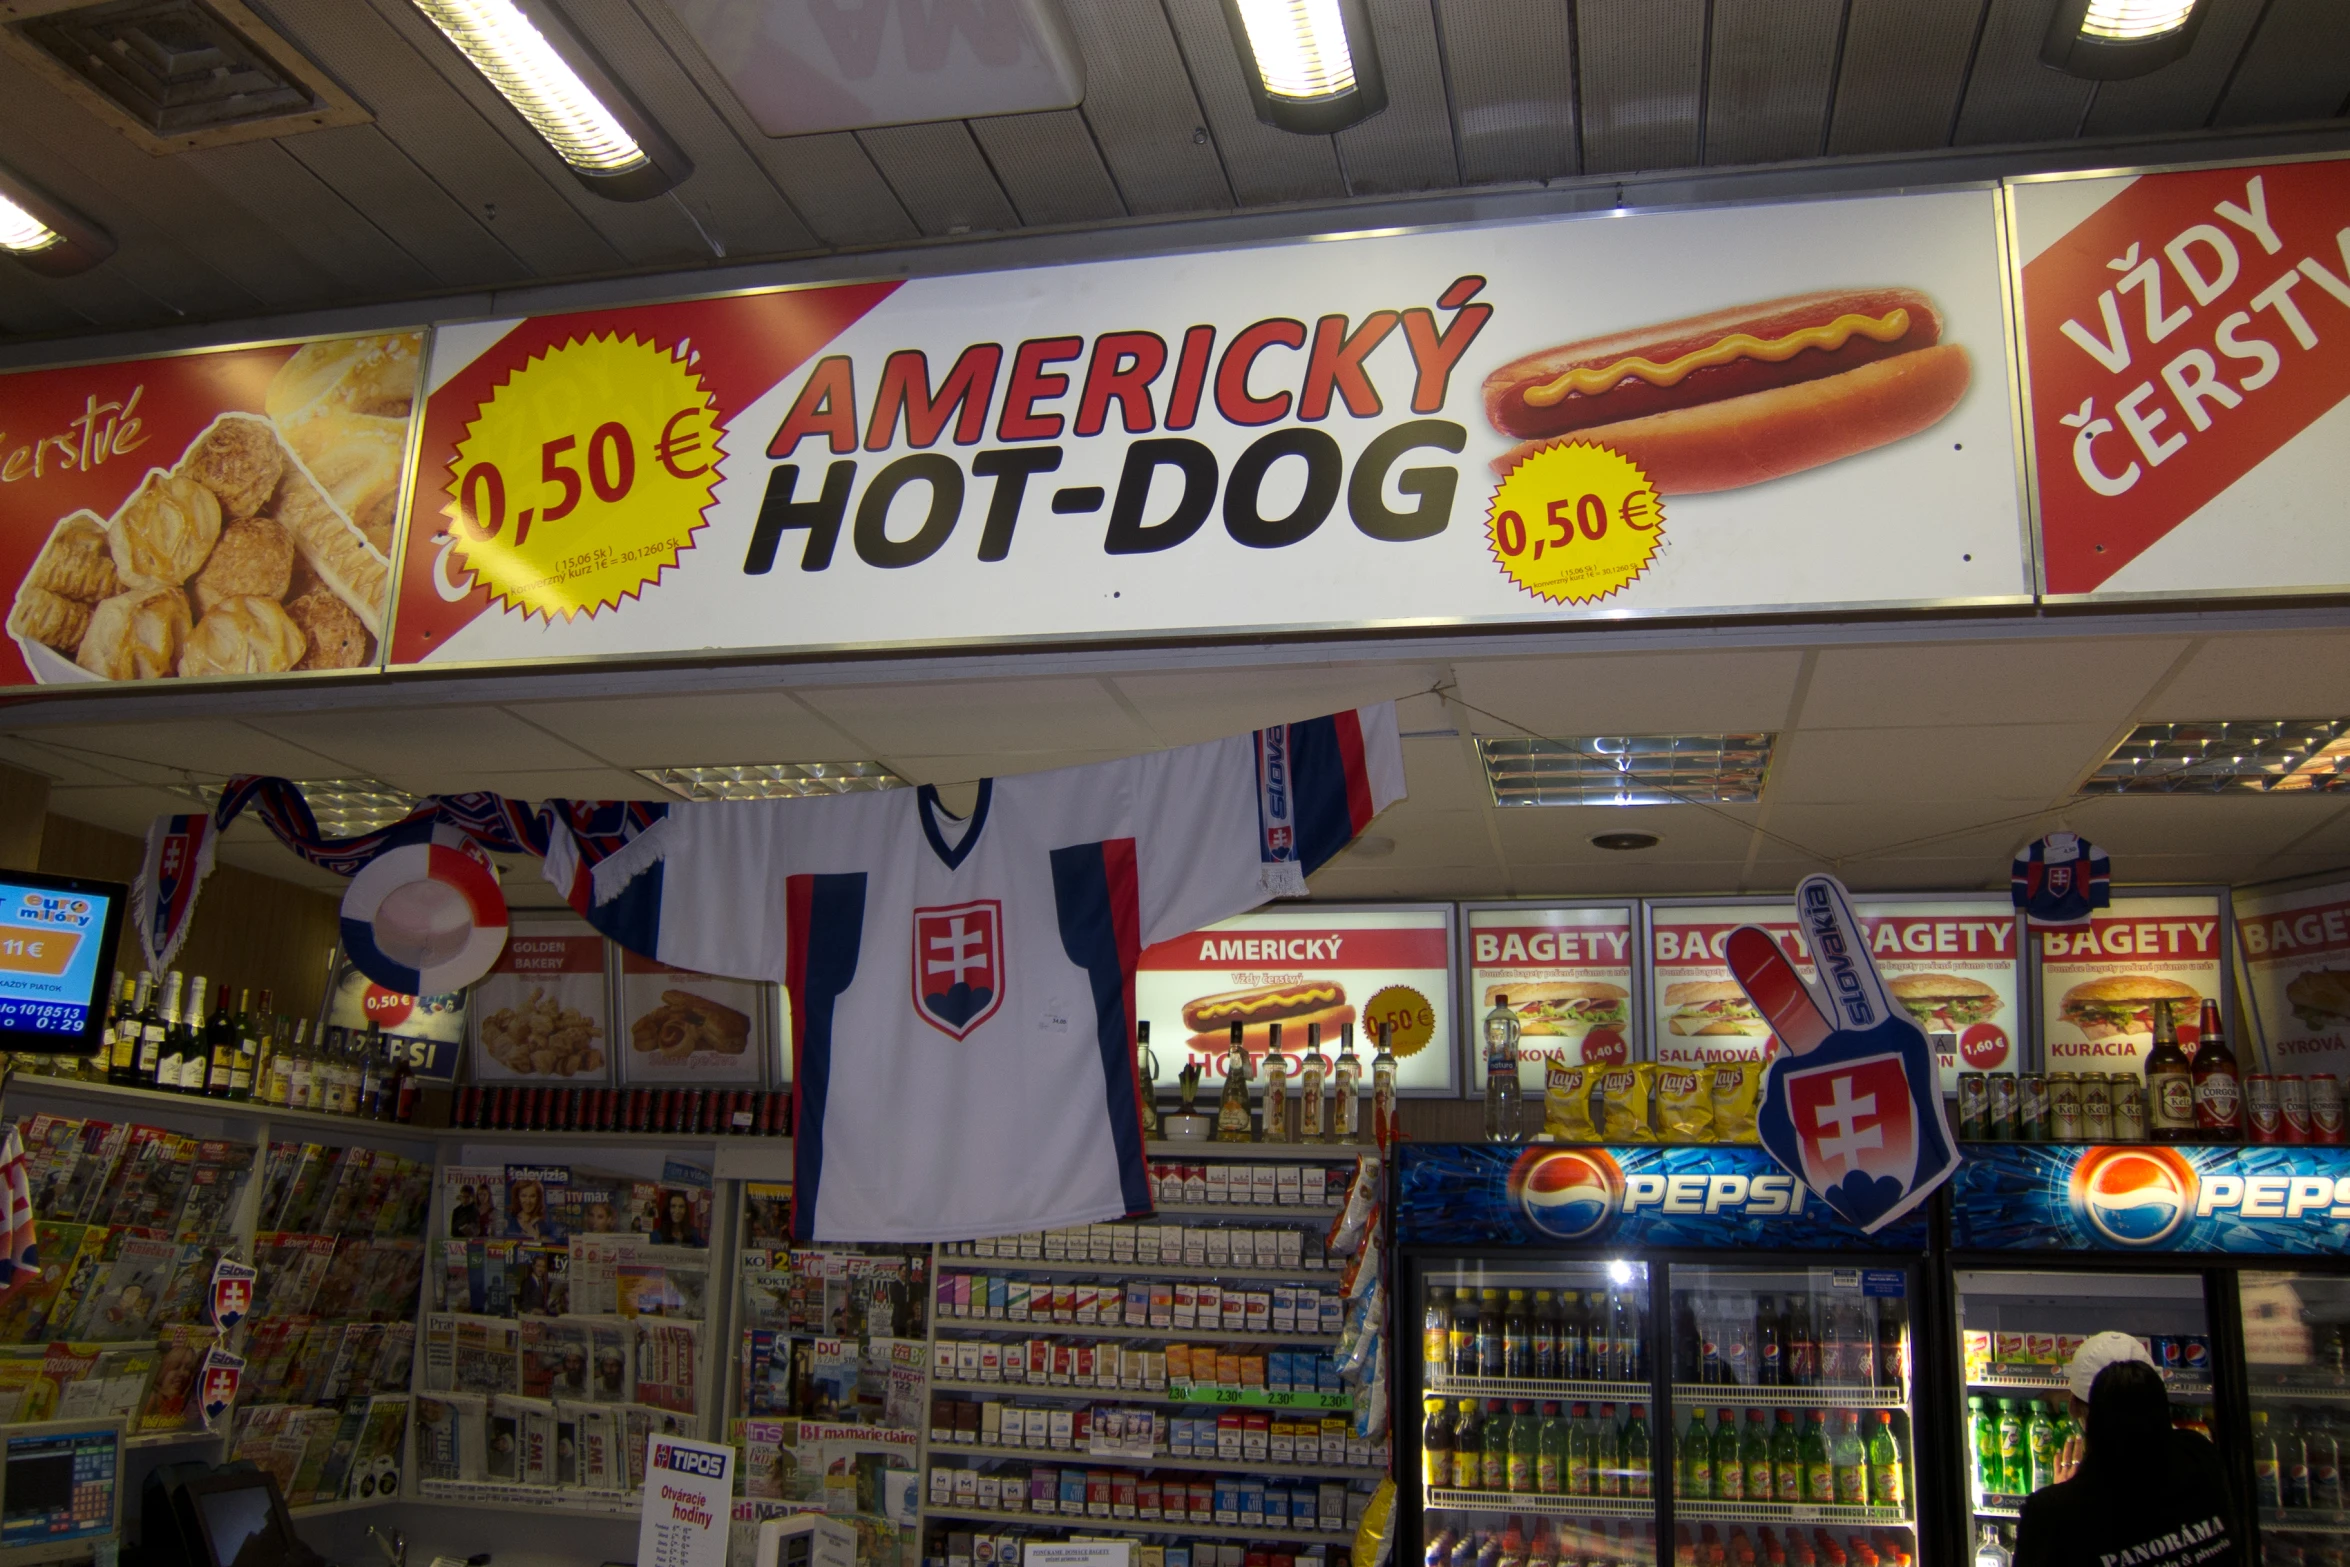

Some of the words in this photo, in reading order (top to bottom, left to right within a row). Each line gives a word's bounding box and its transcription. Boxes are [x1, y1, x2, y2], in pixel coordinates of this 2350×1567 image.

[2060, 175, 2284, 375] VŽDY
[766, 275, 1493, 458] AMERICKÝ
[0, 384, 152, 482] erstvé
[460, 421, 636, 547] 0,50
[653, 407, 711, 480] €
[743, 419, 1467, 575] HOT-DOG
[1496, 493, 1607, 560] 0,50
[1618, 490, 1653, 531] €
[568, 564, 592, 579] kurz
[621, 542, 664, 564] 30,1260
[665, 537, 680, 550] Sk
[2043, 921, 2215, 957] BAGETY
[2243, 908, 2350, 954] BAGE
[513, 942, 565, 953] GOLDEN
[1199, 933, 1343, 961] AMERICKÝ
[1475, 931, 1630, 963] BAGETY
[515, 958, 564, 969] BAKERY
[1887, 961, 1918, 972] bagety
[1231, 973, 1260, 986] Vždy
[1262, 972, 1303, 986] čerstvý
[1479, 969, 1512, 979] Domáce
[1514, 970, 1543, 980] bagety
[30, 983, 63, 992] PIATOK
[19, 1003, 81, 1019] 1018513
[367, 994, 397, 1010] 0,50
[1586, 1044, 1612, 1060] 1,40
[1659, 1044, 1760, 1063] SALÁMOVÁ
[1964, 1039, 1993, 1055] 1,60
[1994, 1036, 2005, 1049] €
[2052, 1043, 2137, 1057] KURACIA
[2277, 1032, 2346, 1057] SYROVÁ
[506, 1166, 569, 1183] televízia
[1216, 1390, 1243, 1402] 2.30€
[1268, 1392, 1295, 1405] 2.30€
[1320, 1395, 1347, 1407] 2.30€
[884, 1431, 917, 1445] claire
[530, 1433, 543, 1471] SME
[589, 1435, 603, 1475] SME
[673, 1450, 722, 1477] TIPOS
[661, 1485, 706, 1507] Otváracie
[672, 1502, 713, 1530] hodiny
